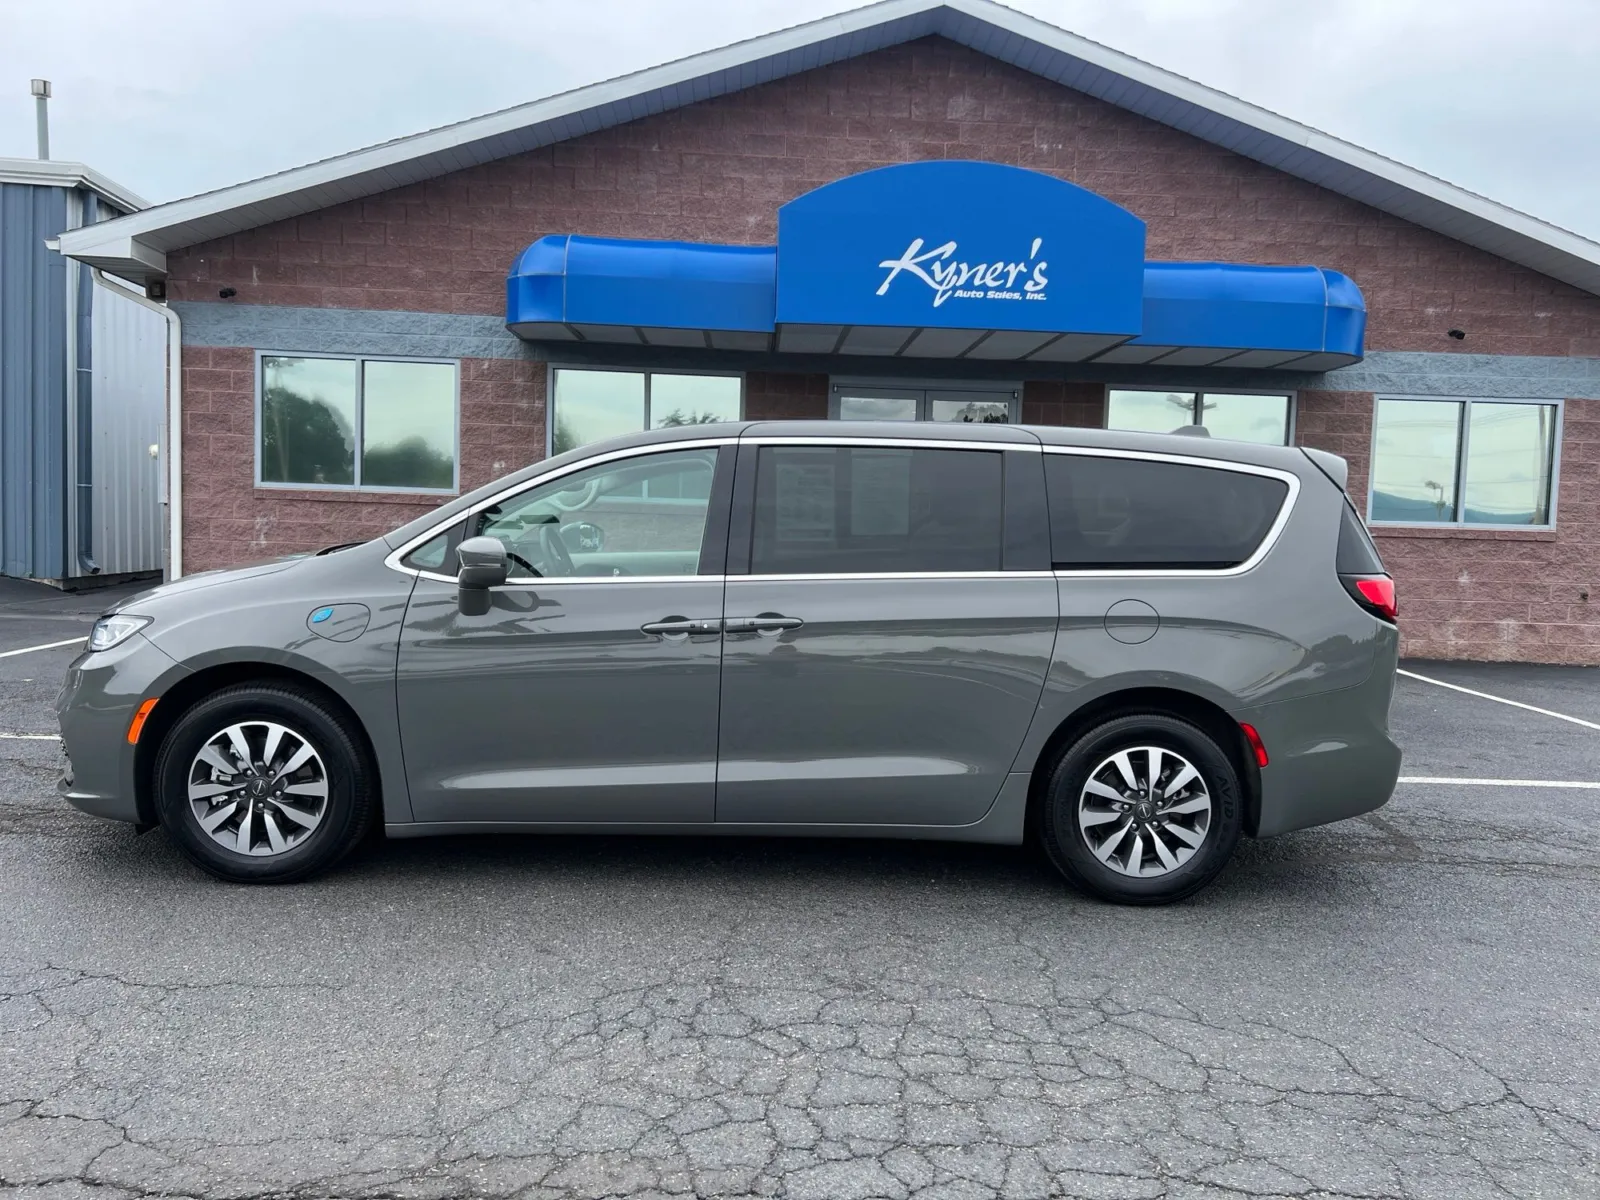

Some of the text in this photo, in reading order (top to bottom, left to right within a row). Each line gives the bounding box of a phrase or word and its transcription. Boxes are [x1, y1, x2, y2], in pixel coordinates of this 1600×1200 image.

[875, 237, 1048, 308] Kyner's
[953, 289, 1047, 301] Auto Sales, Inc.
[1216, 774, 1234, 819] AVID
